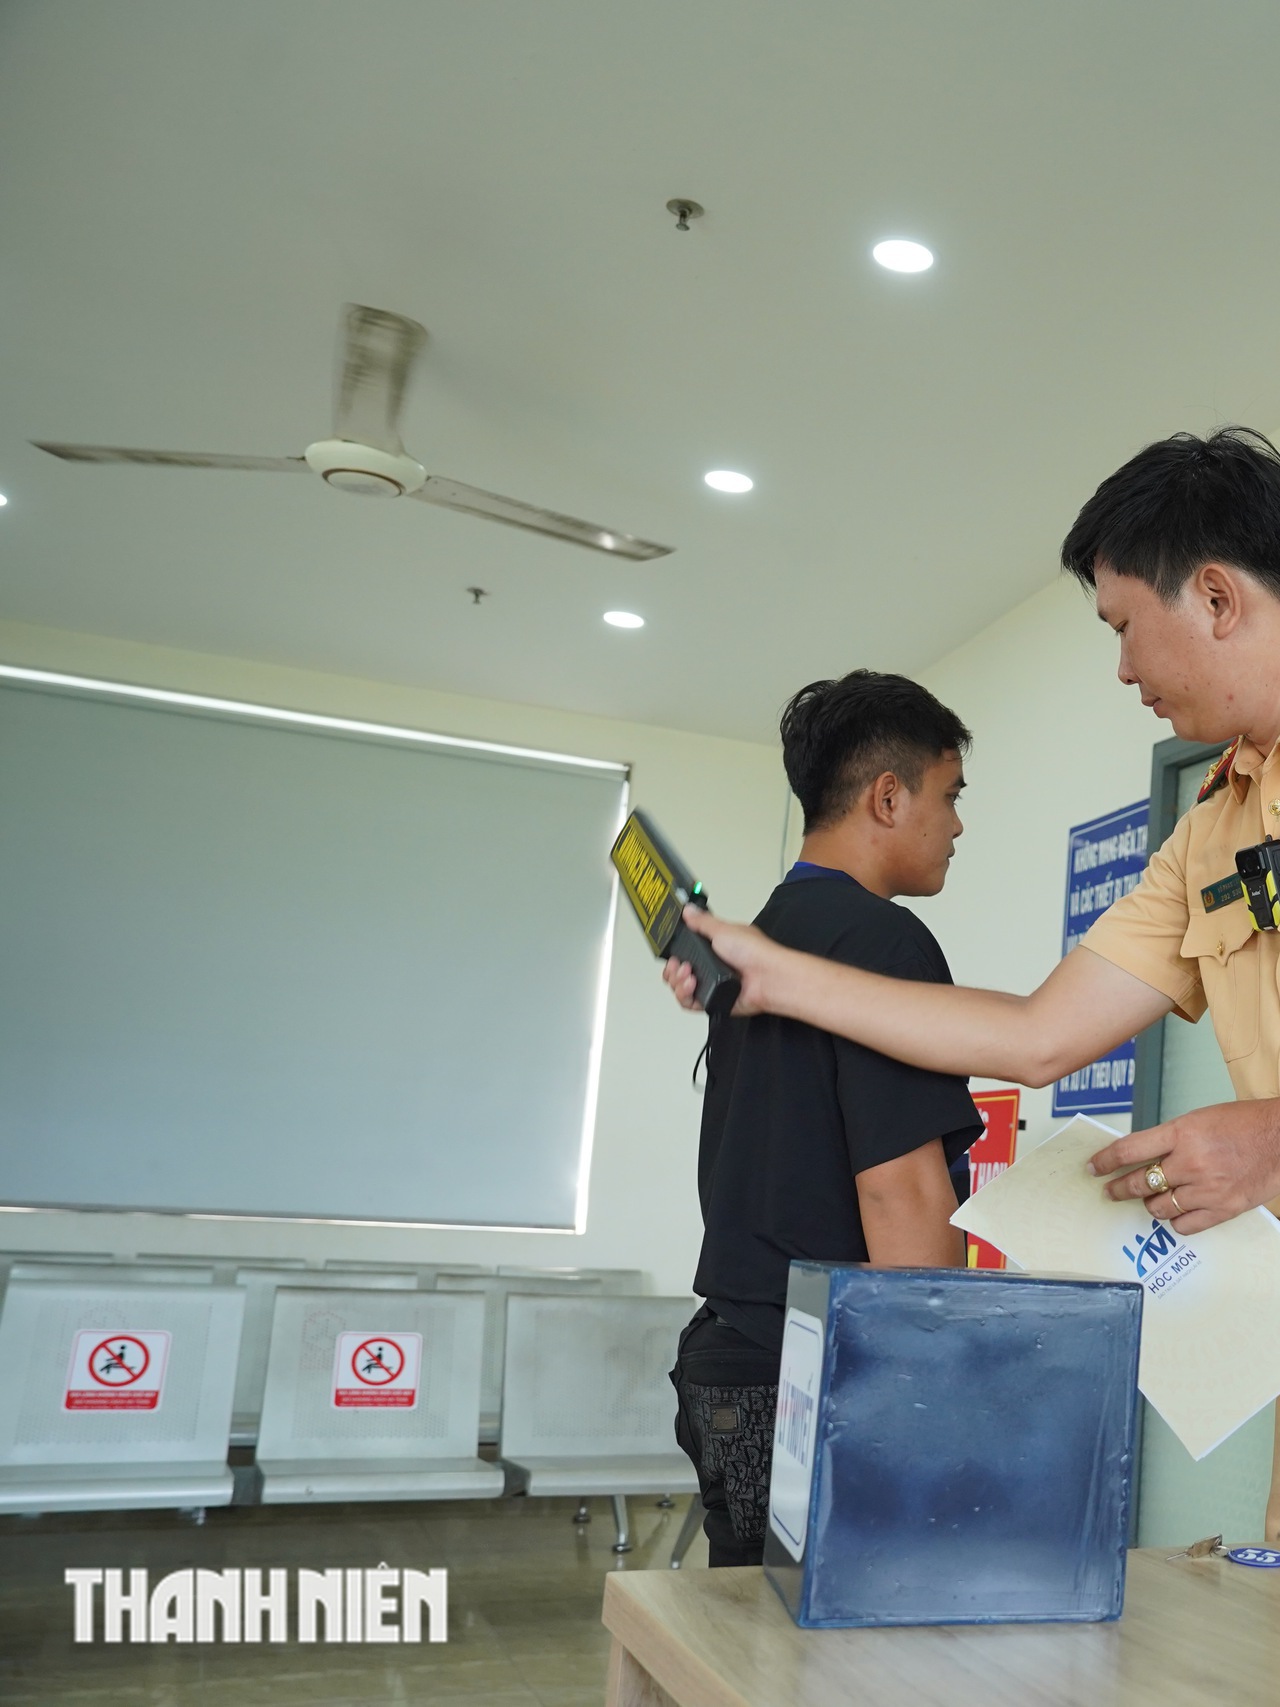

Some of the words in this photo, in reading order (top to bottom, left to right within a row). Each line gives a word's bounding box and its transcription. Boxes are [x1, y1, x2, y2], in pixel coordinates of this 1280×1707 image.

[1111, 1059, 1128, 1092] QUY
[1148, 1272, 1172, 1294] HÓC
[1171, 1250, 1197, 1274] MÔN
[1237, 1549, 1280, 1562] 55
